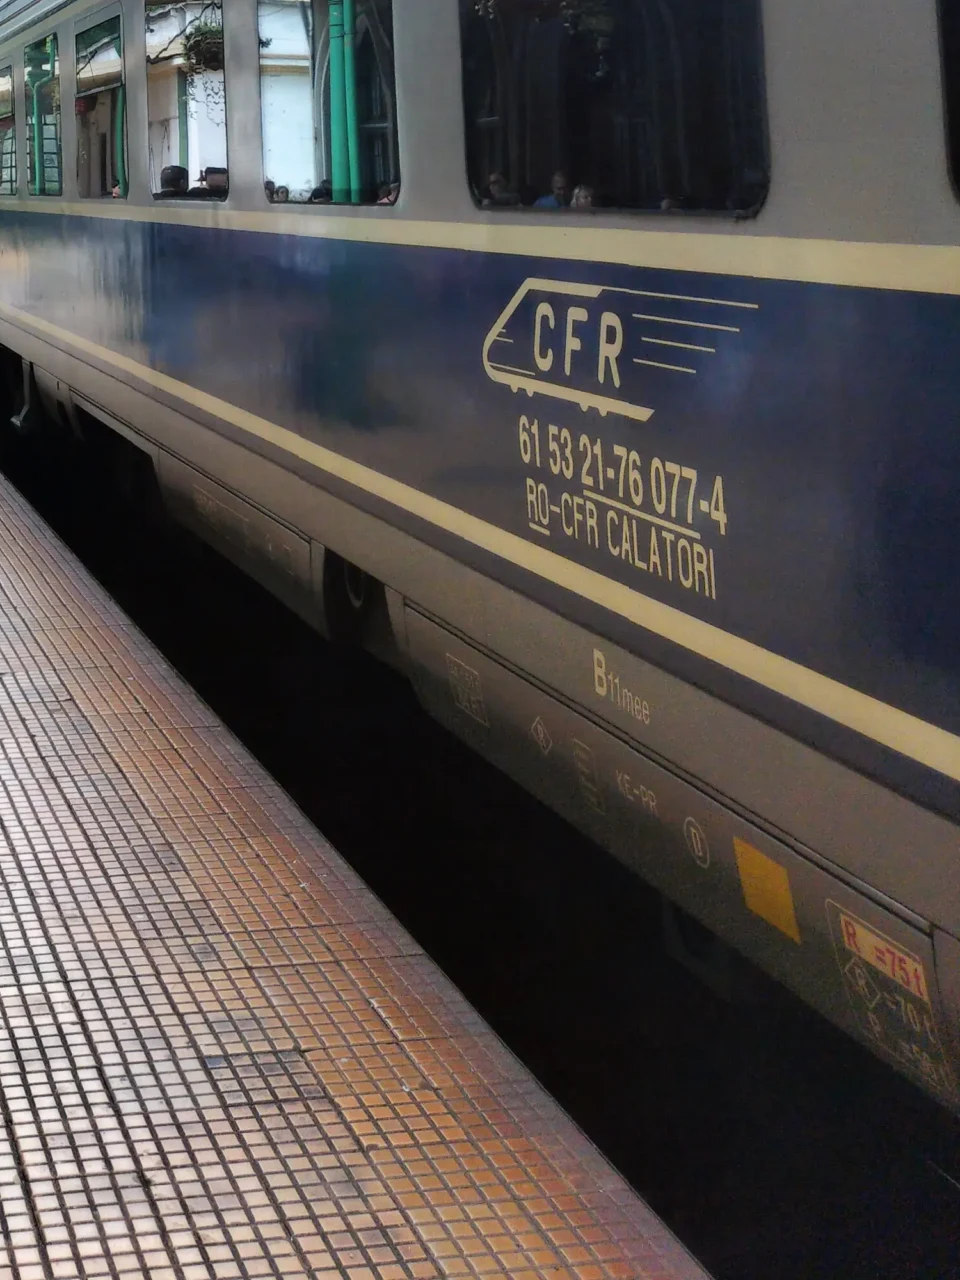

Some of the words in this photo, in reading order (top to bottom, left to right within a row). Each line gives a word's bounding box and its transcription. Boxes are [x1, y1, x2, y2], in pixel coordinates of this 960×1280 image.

[533, 301, 624, 389] CFR
[518, 414, 541, 468] 61
[548, 423, 574, 480] 53
[578, 433, 644, 507] 21-76
[649, 457, 728, 536] 077-4
[525, 477, 600, 550] RO-CFR
[605, 509, 717, 601] CALATORI
